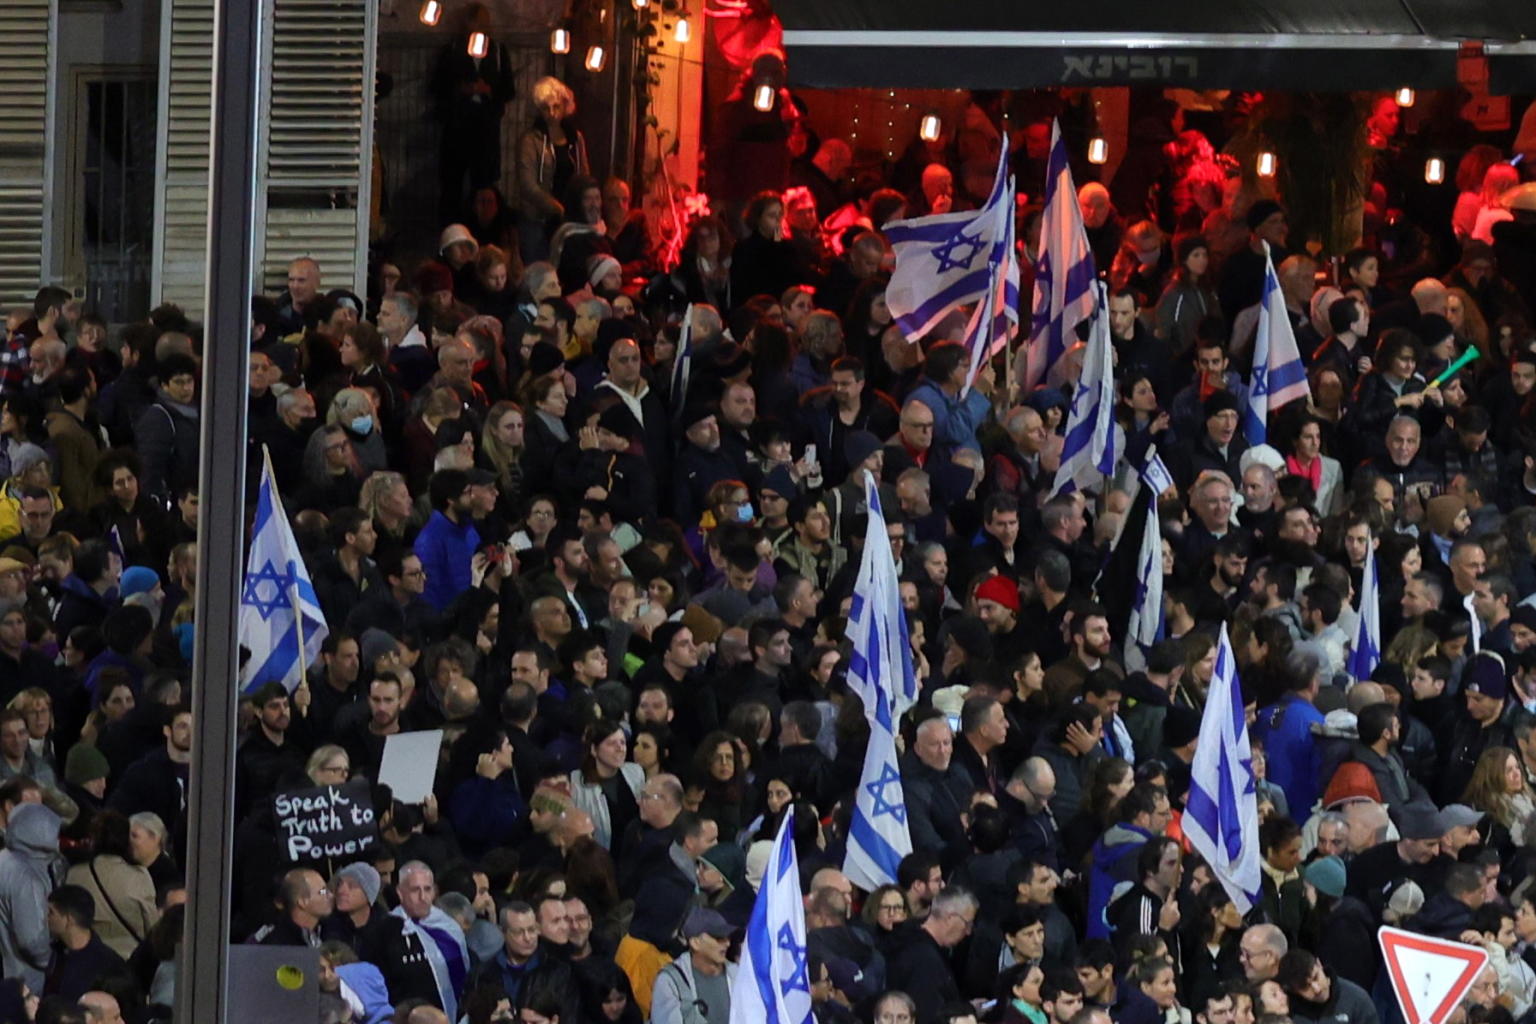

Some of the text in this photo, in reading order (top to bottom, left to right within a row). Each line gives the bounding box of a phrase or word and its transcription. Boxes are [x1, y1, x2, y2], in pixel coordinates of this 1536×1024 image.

[1060, 54, 1198, 82] רובינא
[275, 784, 350, 817] Speak
[281, 803, 374, 836] Truth to
[288, 835, 374, 862] Power
